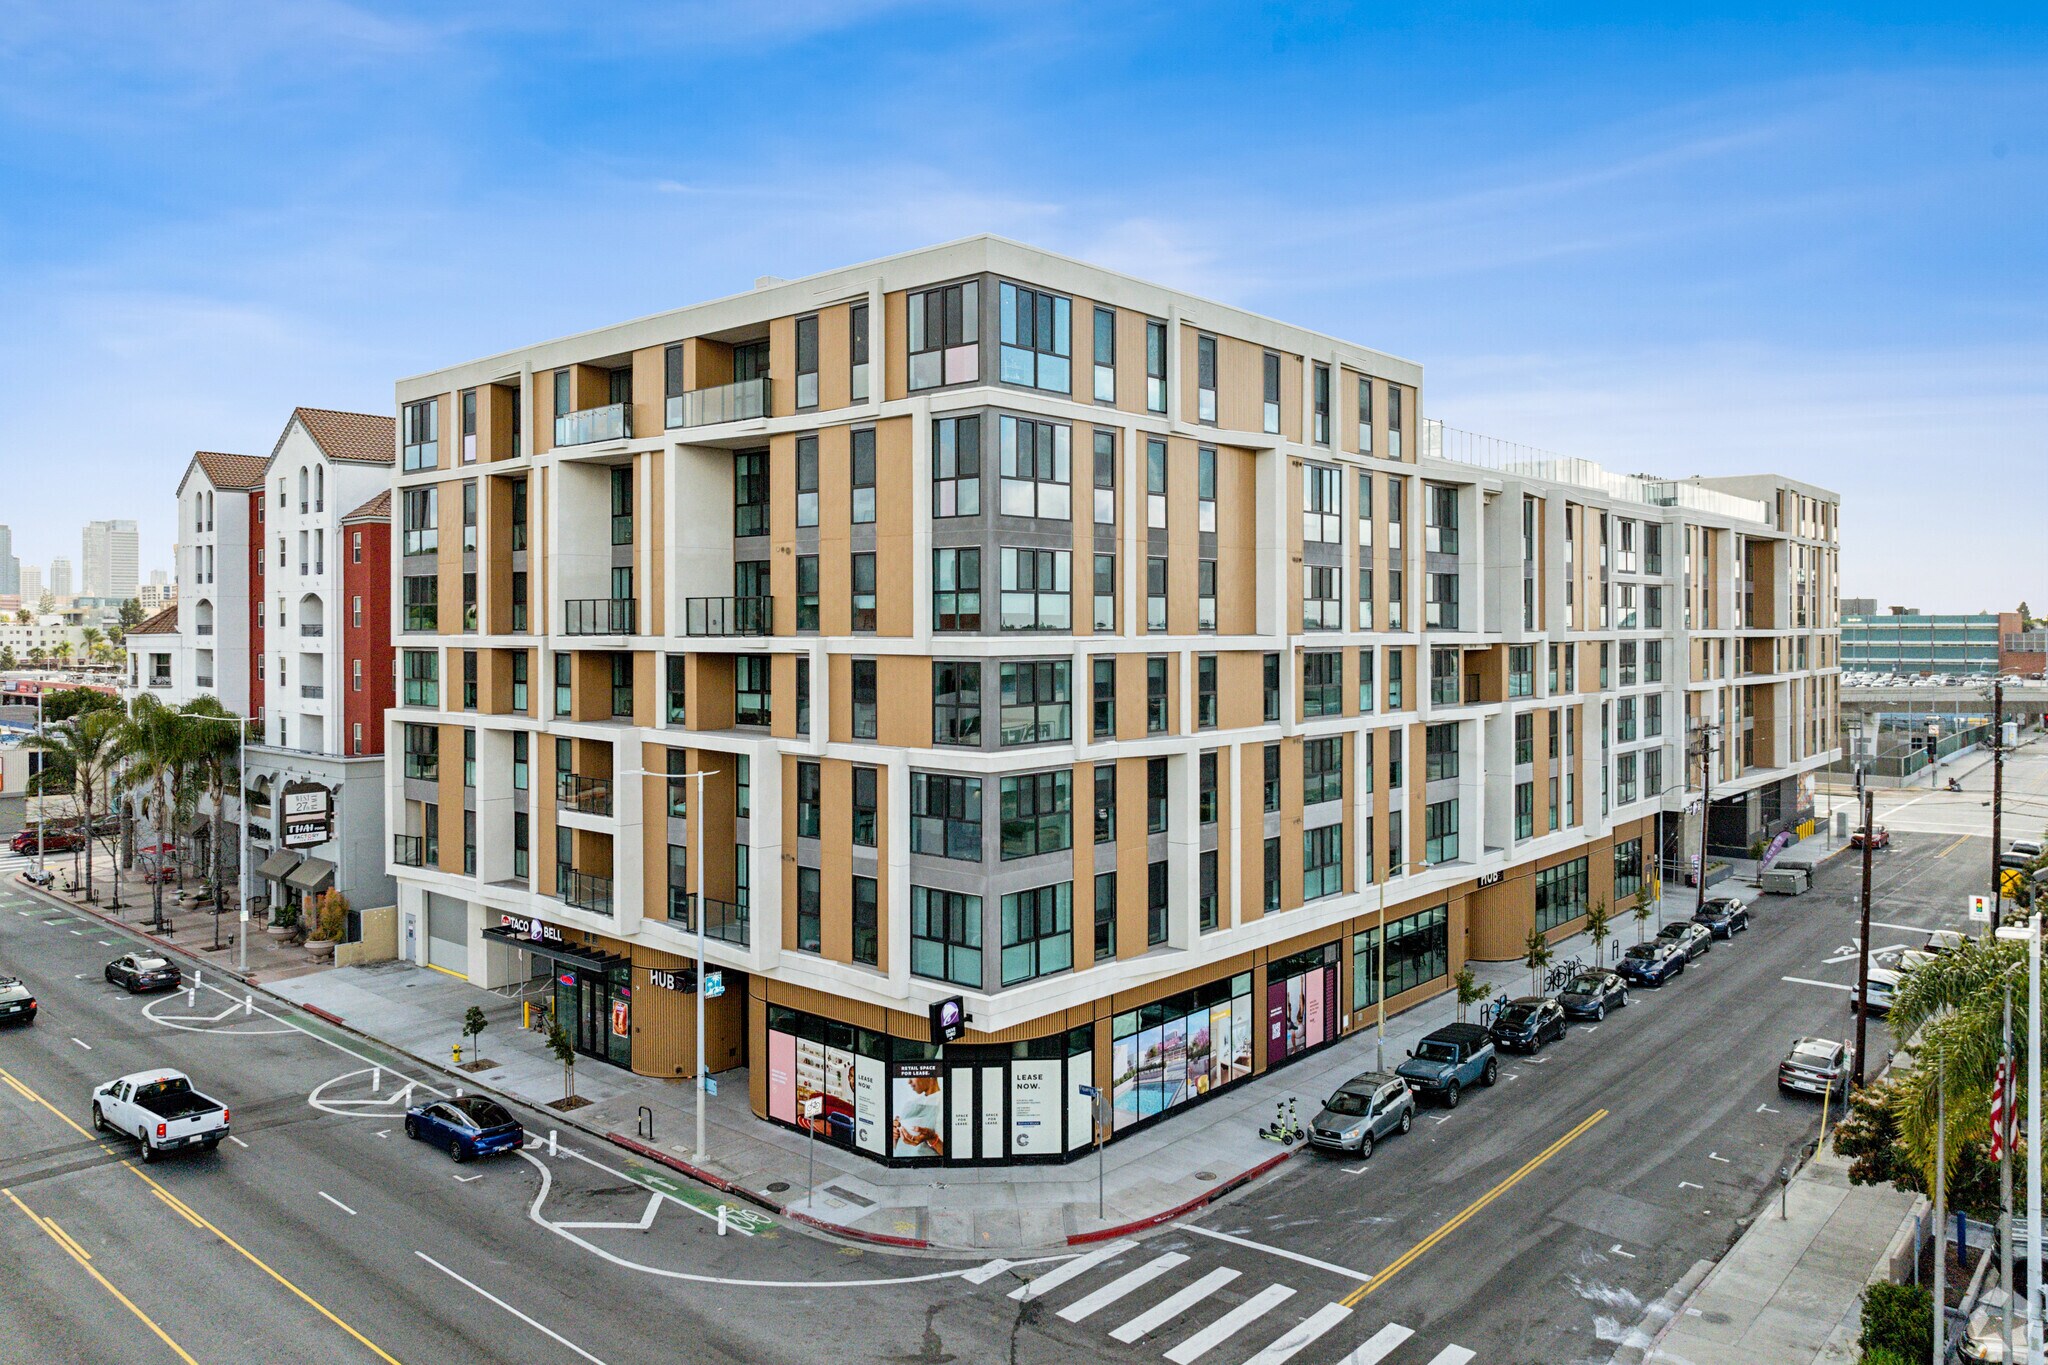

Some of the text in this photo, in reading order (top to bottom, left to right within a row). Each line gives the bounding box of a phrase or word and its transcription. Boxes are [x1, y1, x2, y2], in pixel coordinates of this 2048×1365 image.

[288, 824, 313, 833] THAI
[510, 916, 562, 941] TACO BELL
[650, 969, 675, 990] HUB
[858, 1074, 873, 1083] LEASE
[858, 1082, 872, 1090] NOW.
